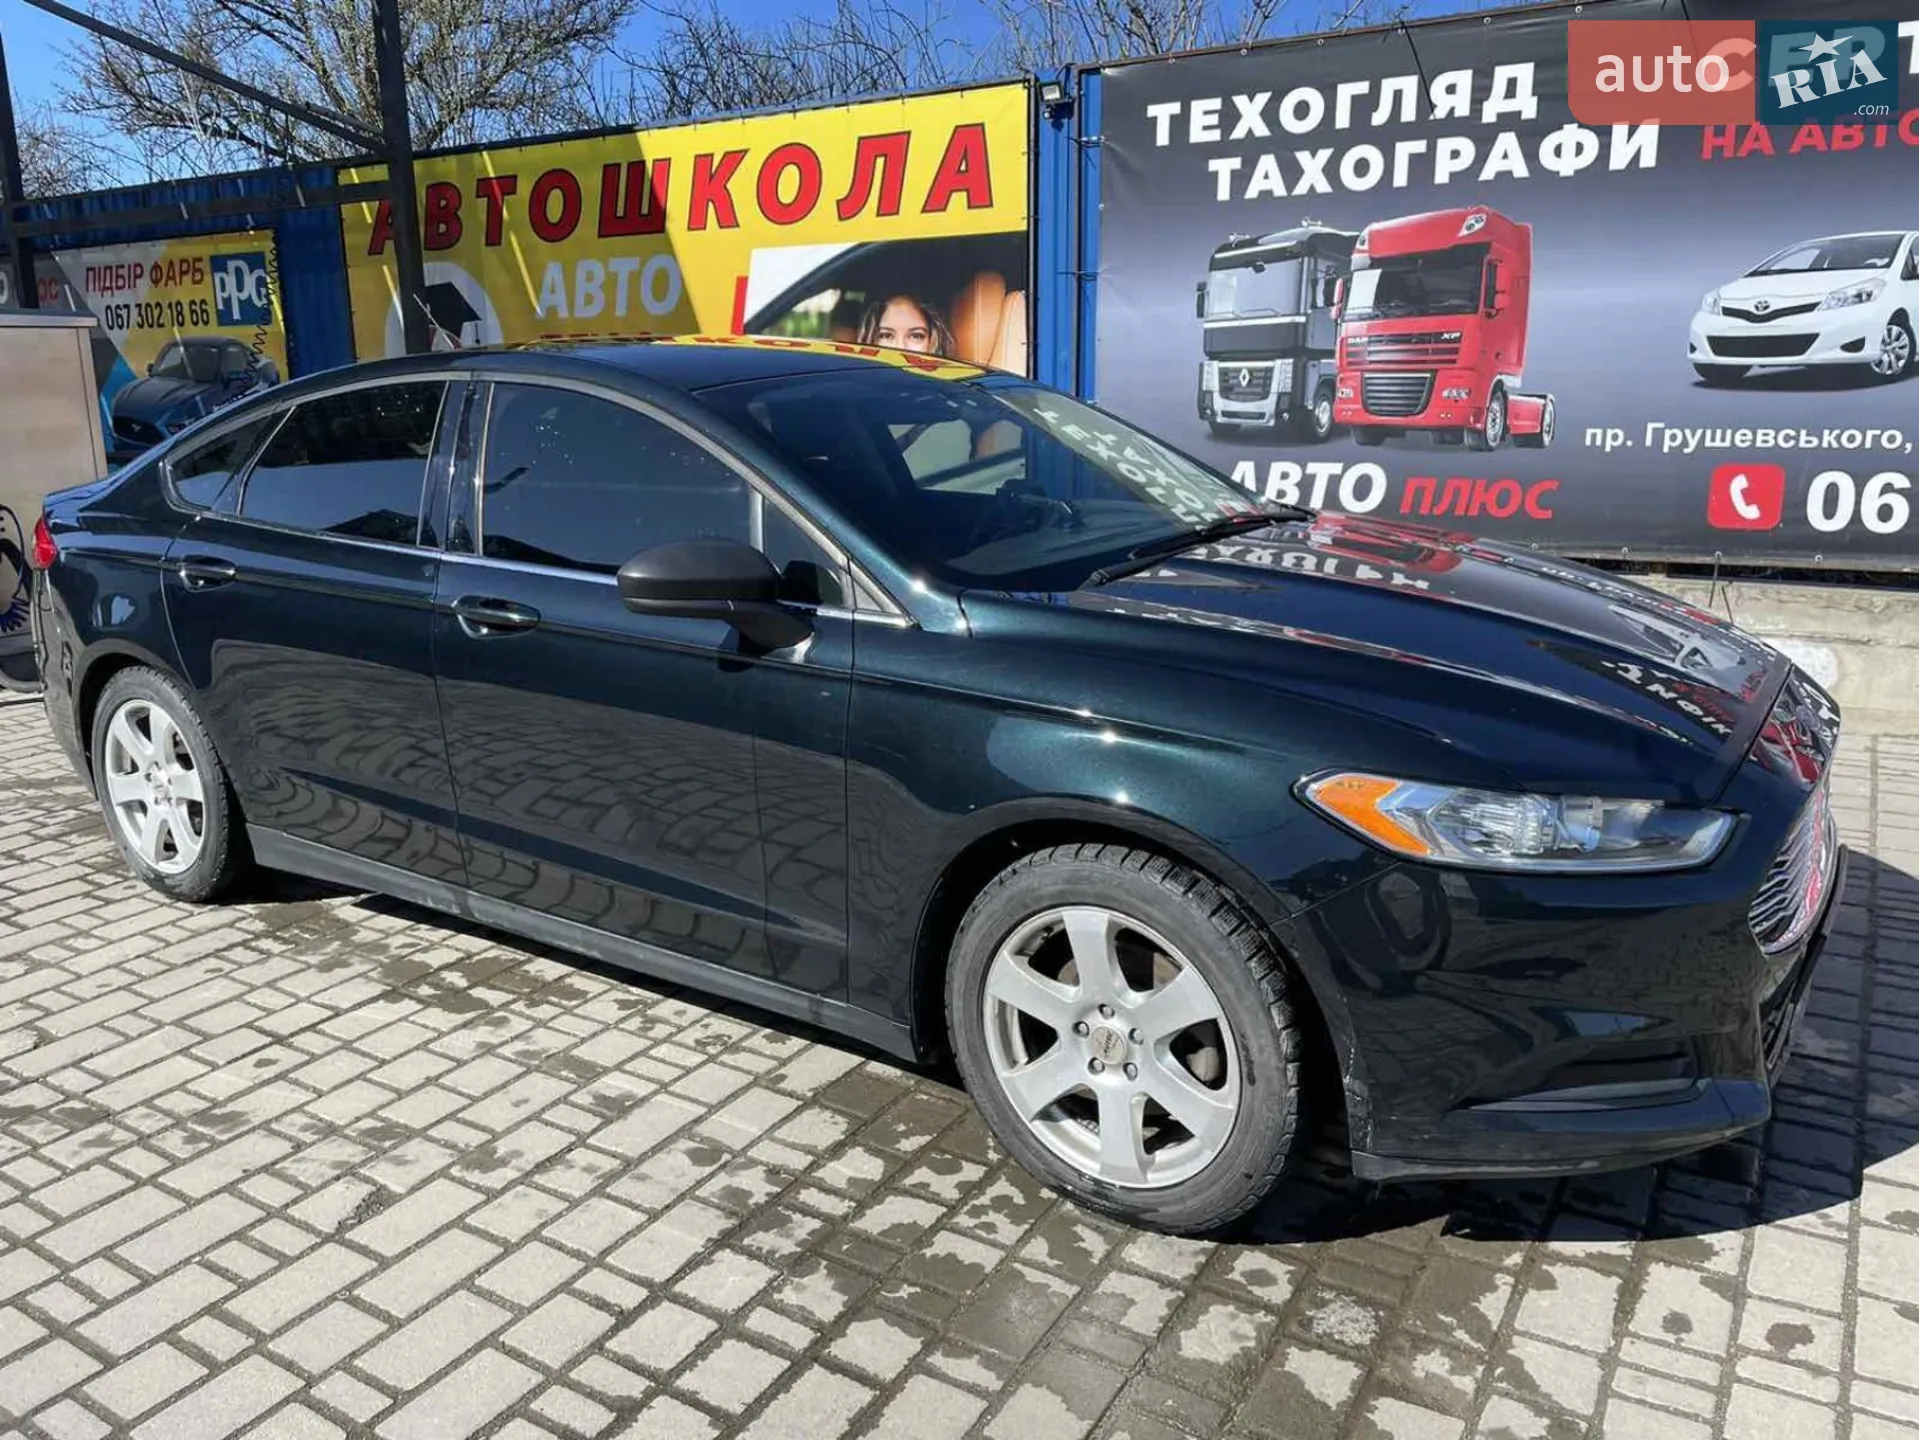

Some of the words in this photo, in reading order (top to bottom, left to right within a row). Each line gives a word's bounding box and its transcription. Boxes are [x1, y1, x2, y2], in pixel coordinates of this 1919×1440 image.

[1147, 61, 1538, 146] ТЕХОГЛЯД
[1208, 119, 1662, 201] ТАХОГРАФИ
[1702, 120, 1775, 160] НА
[85, 264, 145, 298] ПІДБІР
[149, 257, 204, 289] ФАРБ
[535, 253, 682, 320] АВТО
[105, 303, 135, 331] 067
[137, 302, 165, 329] 302
[167, 300, 186, 329] 18
[189, 298, 210, 326] 66
[1585, 428, 1633, 452] пр.
[1645, 421, 1914, 455] Грушевського,
[1230, 461, 1388, 514] АВТО
[1400, 478, 1560, 519] ПЛЮС
[1806, 470, 1912, 535] 06
